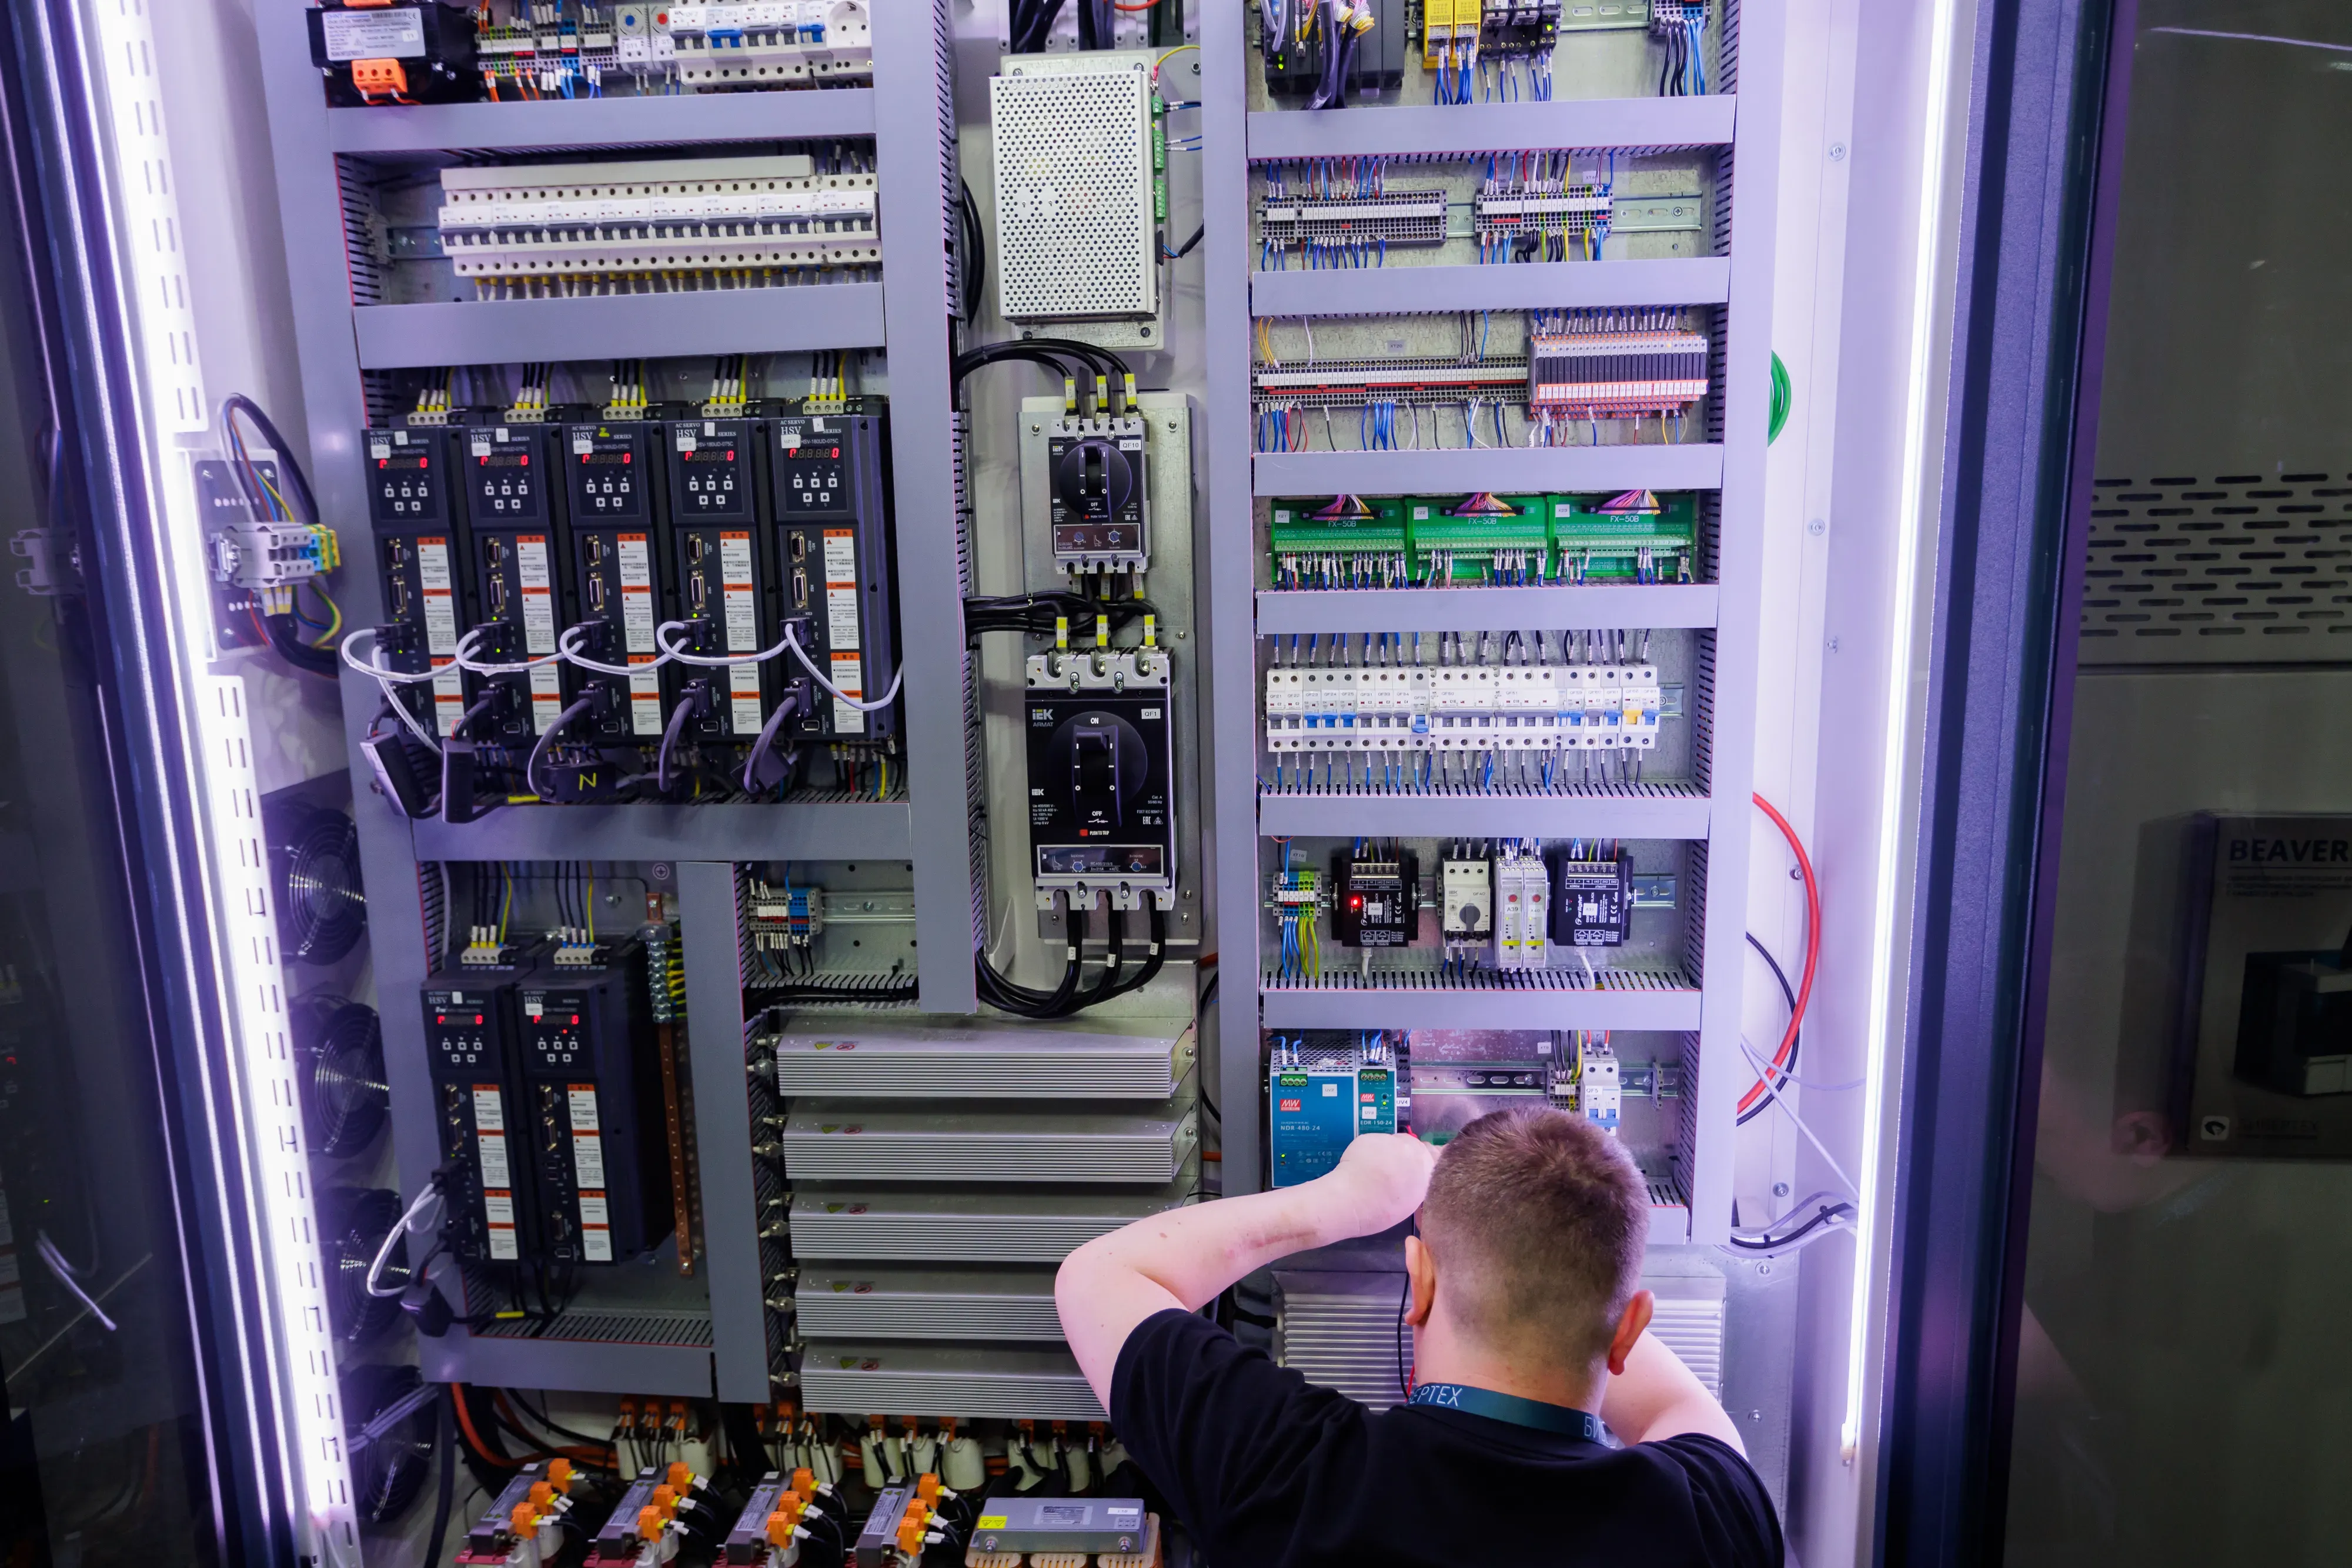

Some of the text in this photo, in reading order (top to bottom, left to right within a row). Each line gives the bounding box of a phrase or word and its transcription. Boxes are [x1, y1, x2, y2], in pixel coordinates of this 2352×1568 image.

[676, 429, 697, 438] HSV
[781, 426, 801, 434] HSV
[471, 434, 492, 443] HSV
[573, 432, 593, 441] HSV
[1033, 709, 1053, 720] IEK
[579, 772, 597, 791] N
[2229, 838, 2349, 862] BEAVER
[1395, 905, 1402, 914] CE
[1611, 905, 1618, 914] CE
